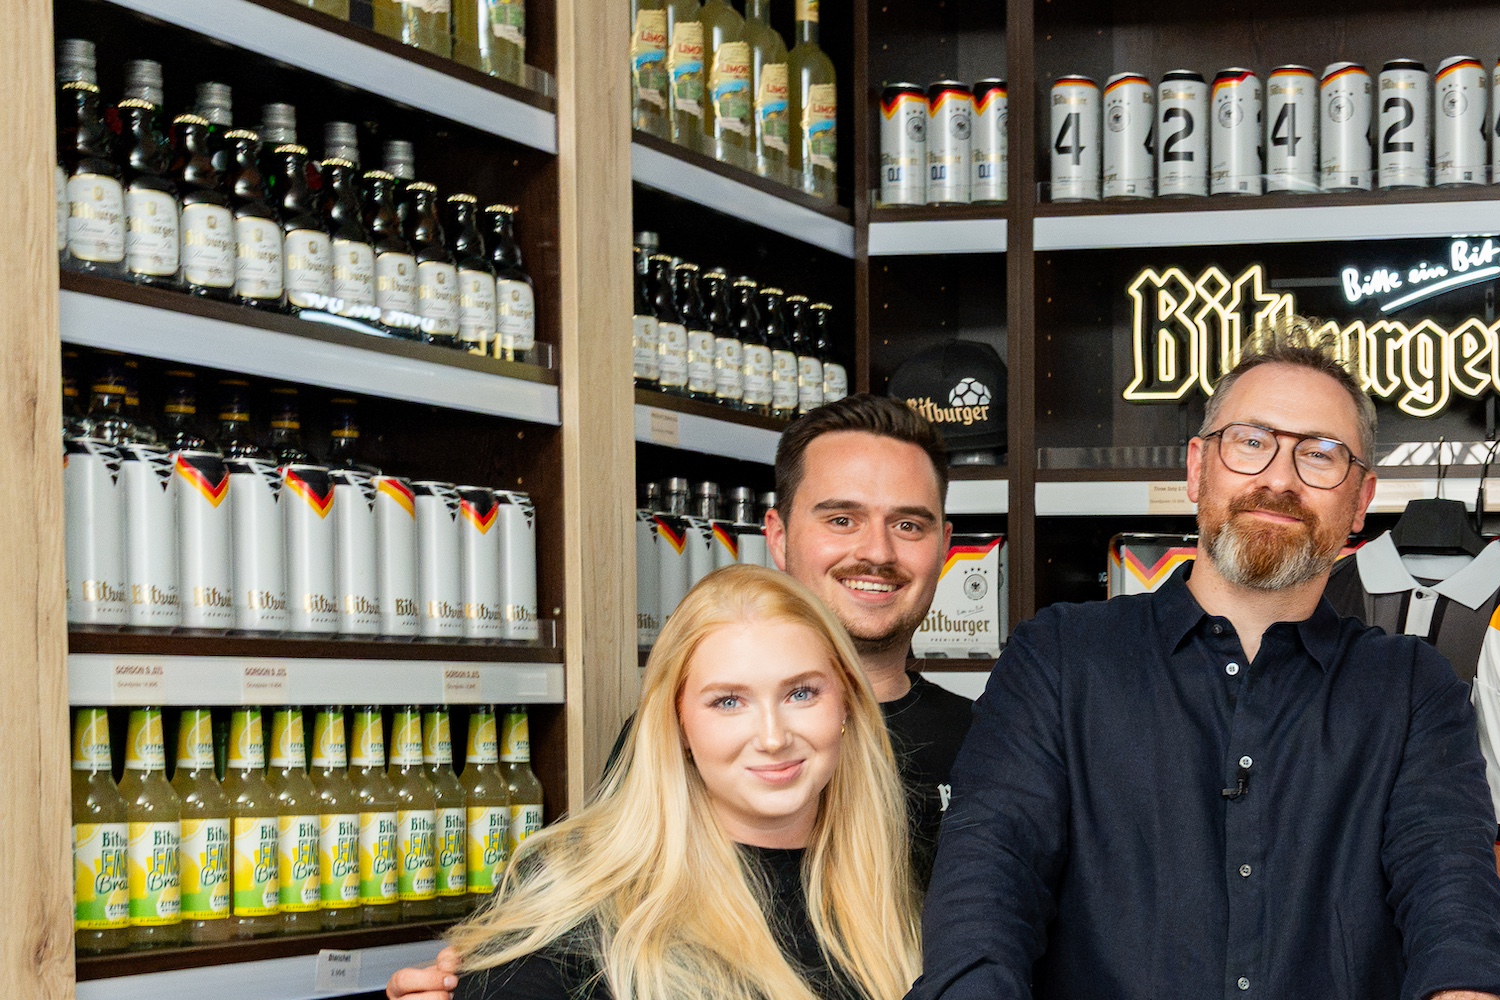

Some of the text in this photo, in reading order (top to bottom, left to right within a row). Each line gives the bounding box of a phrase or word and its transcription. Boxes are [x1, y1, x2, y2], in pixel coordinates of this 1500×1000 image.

[1055, 112, 1086, 166] 4
[1162, 107, 1194, 162] 2
[1270, 103, 1302, 157] 4
[1382, 97, 1414, 154] 2
[1341, 266, 1402, 302] Bitte
[1408, 261, 1448, 284] ein
